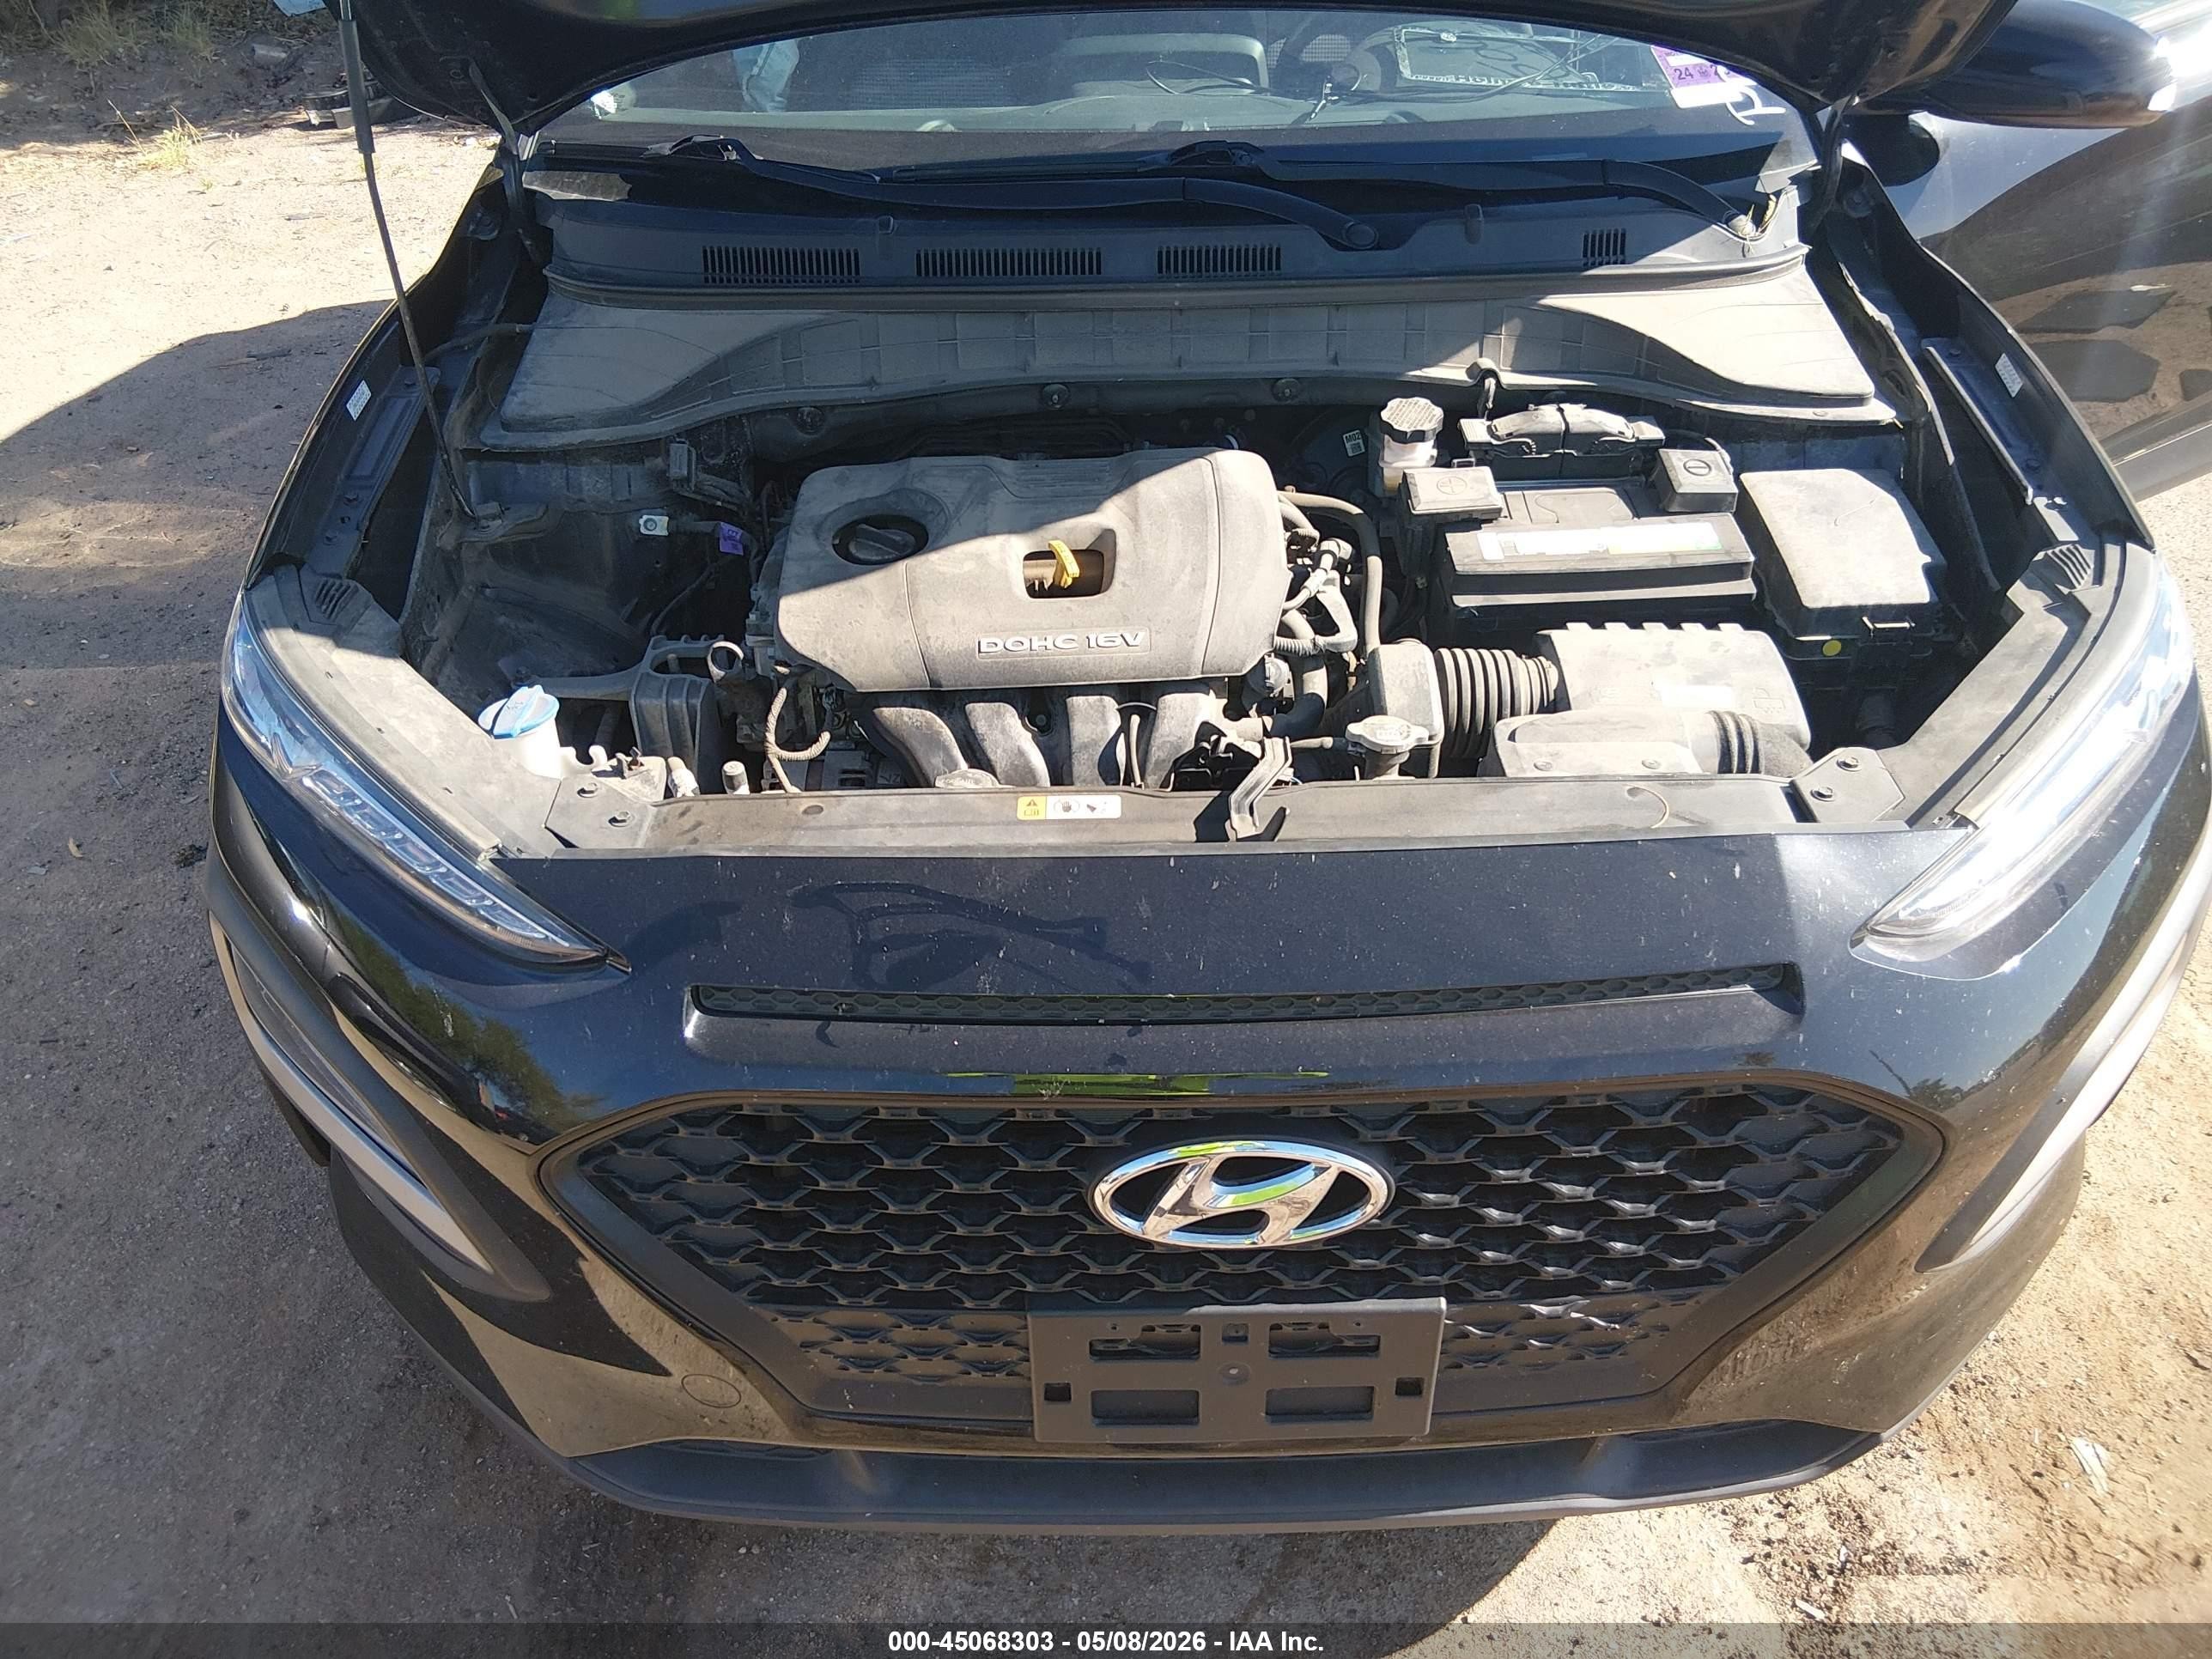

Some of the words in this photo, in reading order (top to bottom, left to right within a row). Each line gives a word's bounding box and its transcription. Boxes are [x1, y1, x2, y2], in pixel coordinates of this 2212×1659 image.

[1674, 67, 1693, 80] 24
[977, 634, 1079, 653] DOHC
[1086, 631, 1146, 649] 16V
